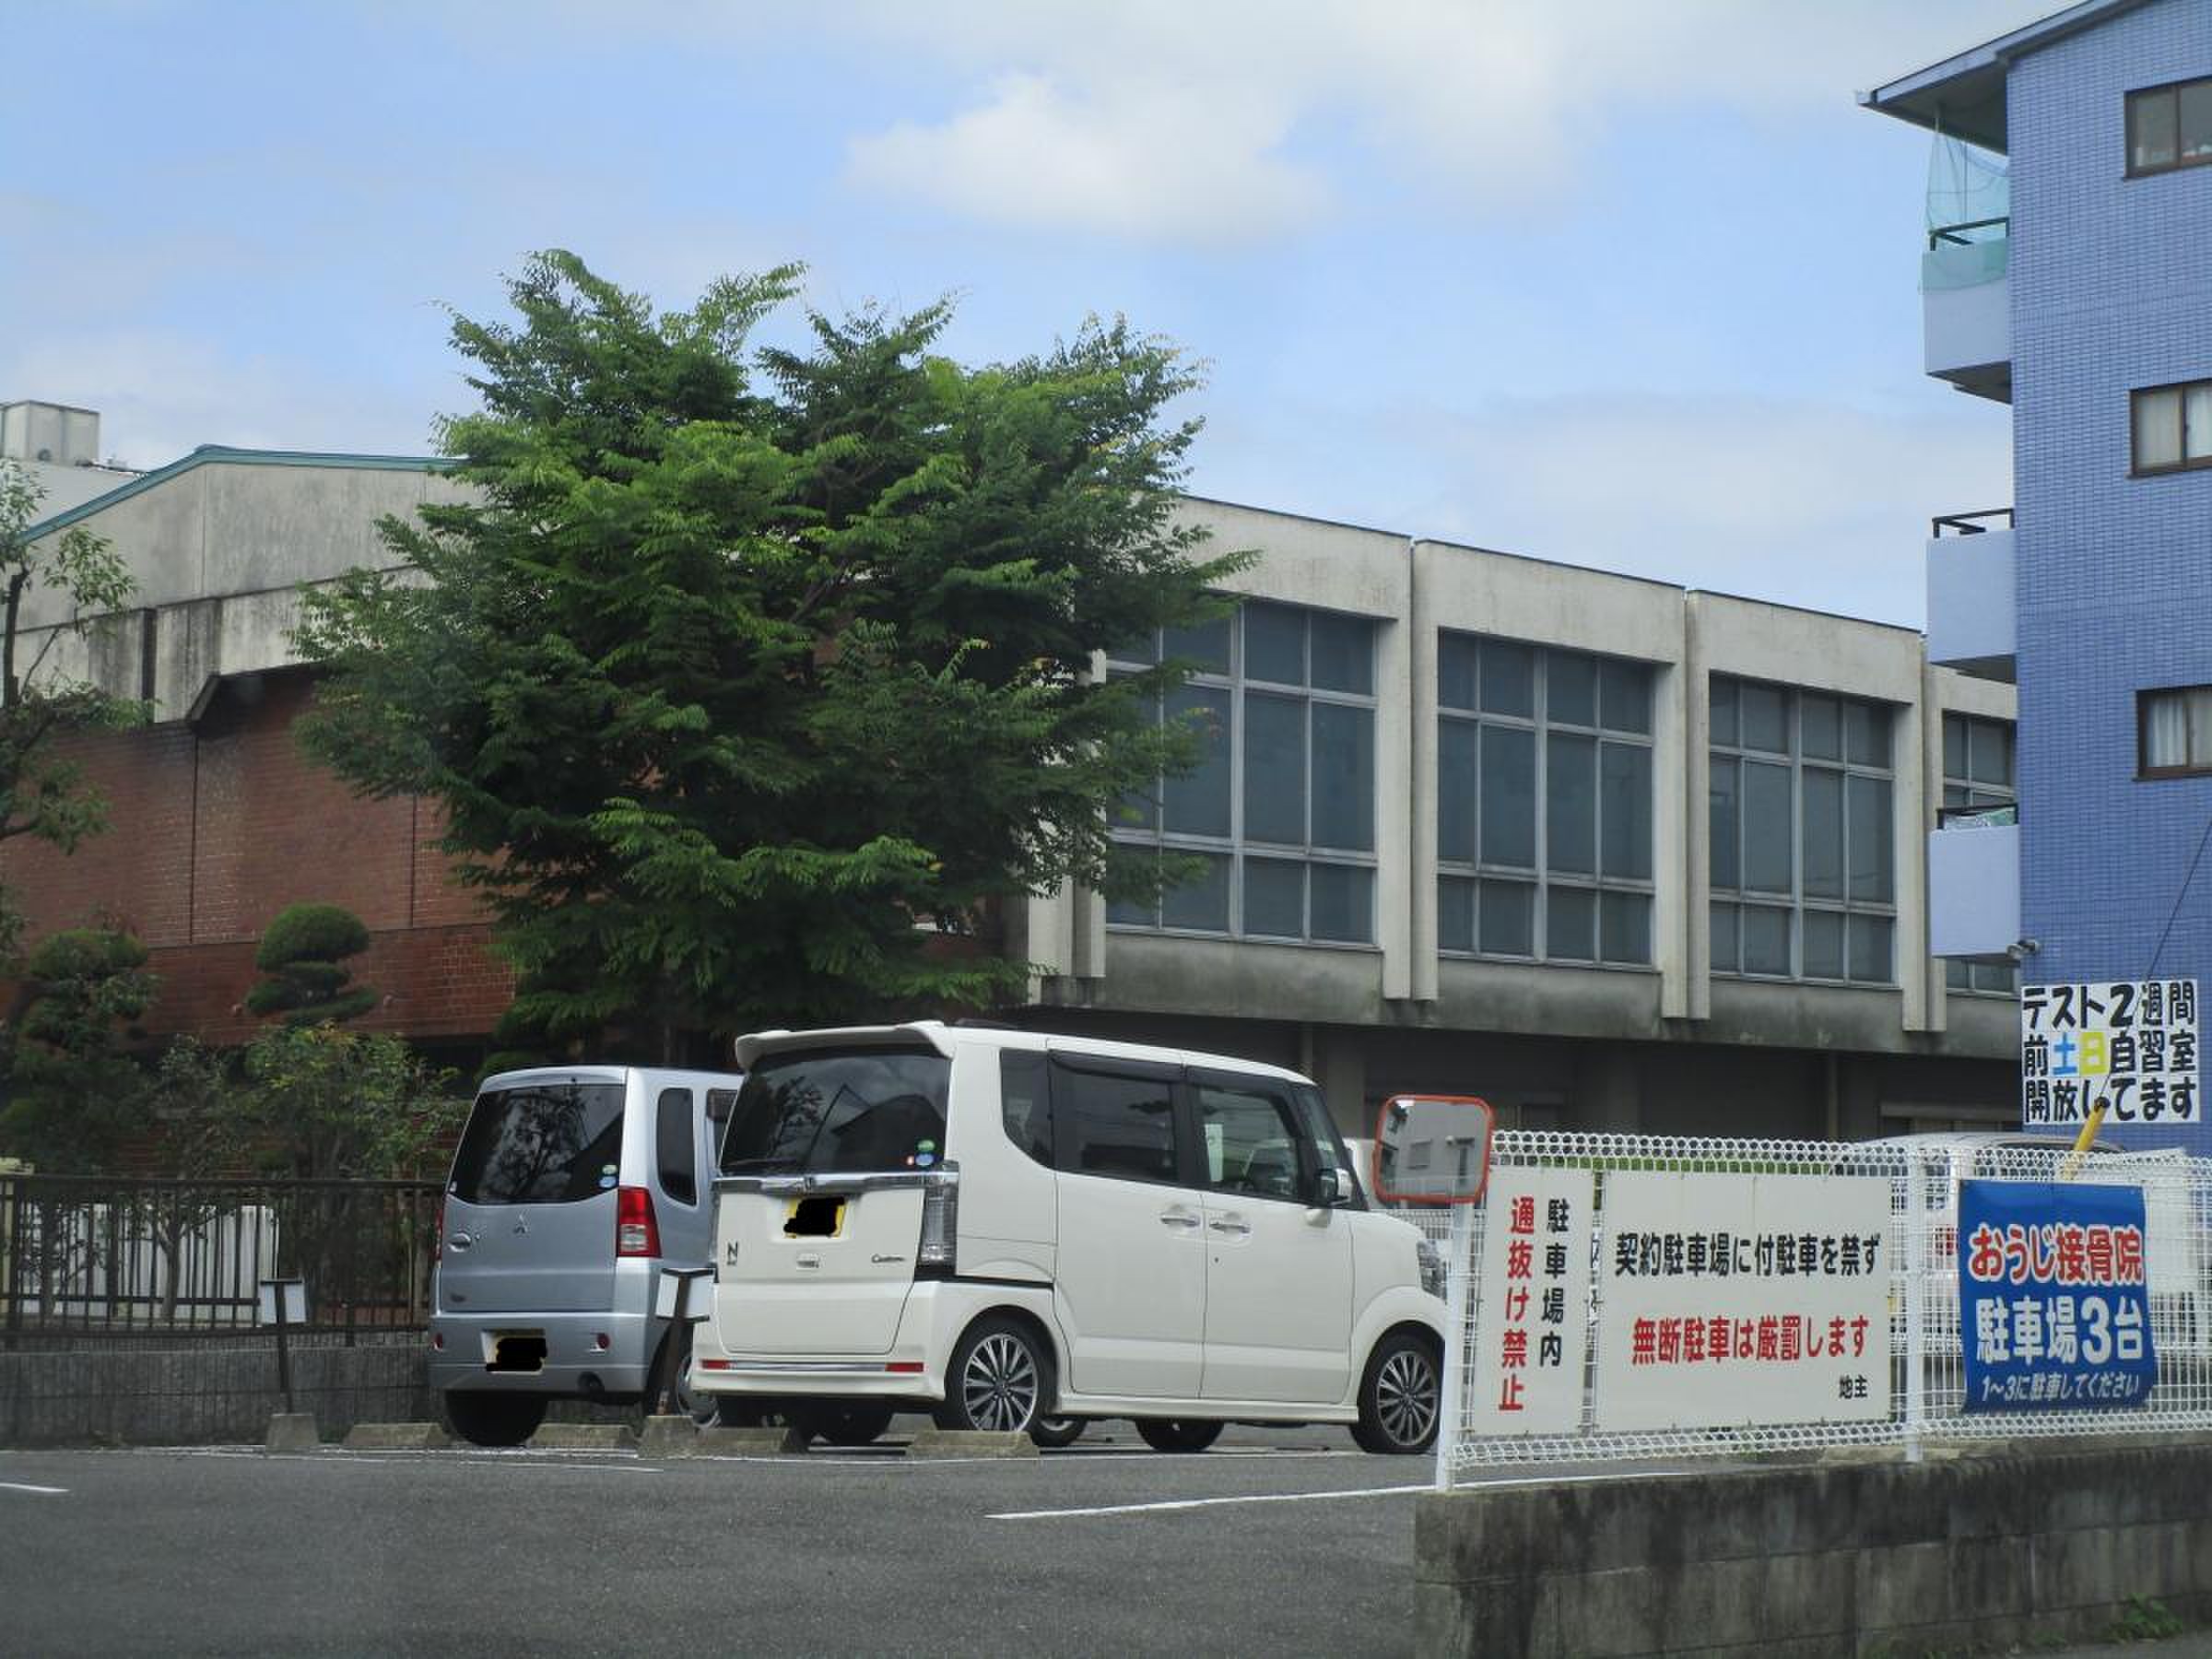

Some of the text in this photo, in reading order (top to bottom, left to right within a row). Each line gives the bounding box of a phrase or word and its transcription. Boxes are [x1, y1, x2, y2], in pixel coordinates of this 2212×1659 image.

[2023, 981, 2195, 1029] テスト2週間
[2024, 1029, 2196, 1077] 前土日自習室
[1615, 1232, 1880, 1277] 契約駐車場に付駐車を禁ず
[1969, 1223, 2145, 1285] おうじ接骨院
[1499, 1196, 1535, 1411] 通抜け禁止
[1539, 1198, 1570, 1367] 駐車場内
[1631, 1315, 1869, 1365] 無断駐車は厳罰します
[1975, 1295, 2144, 1365] 駐車場3台
